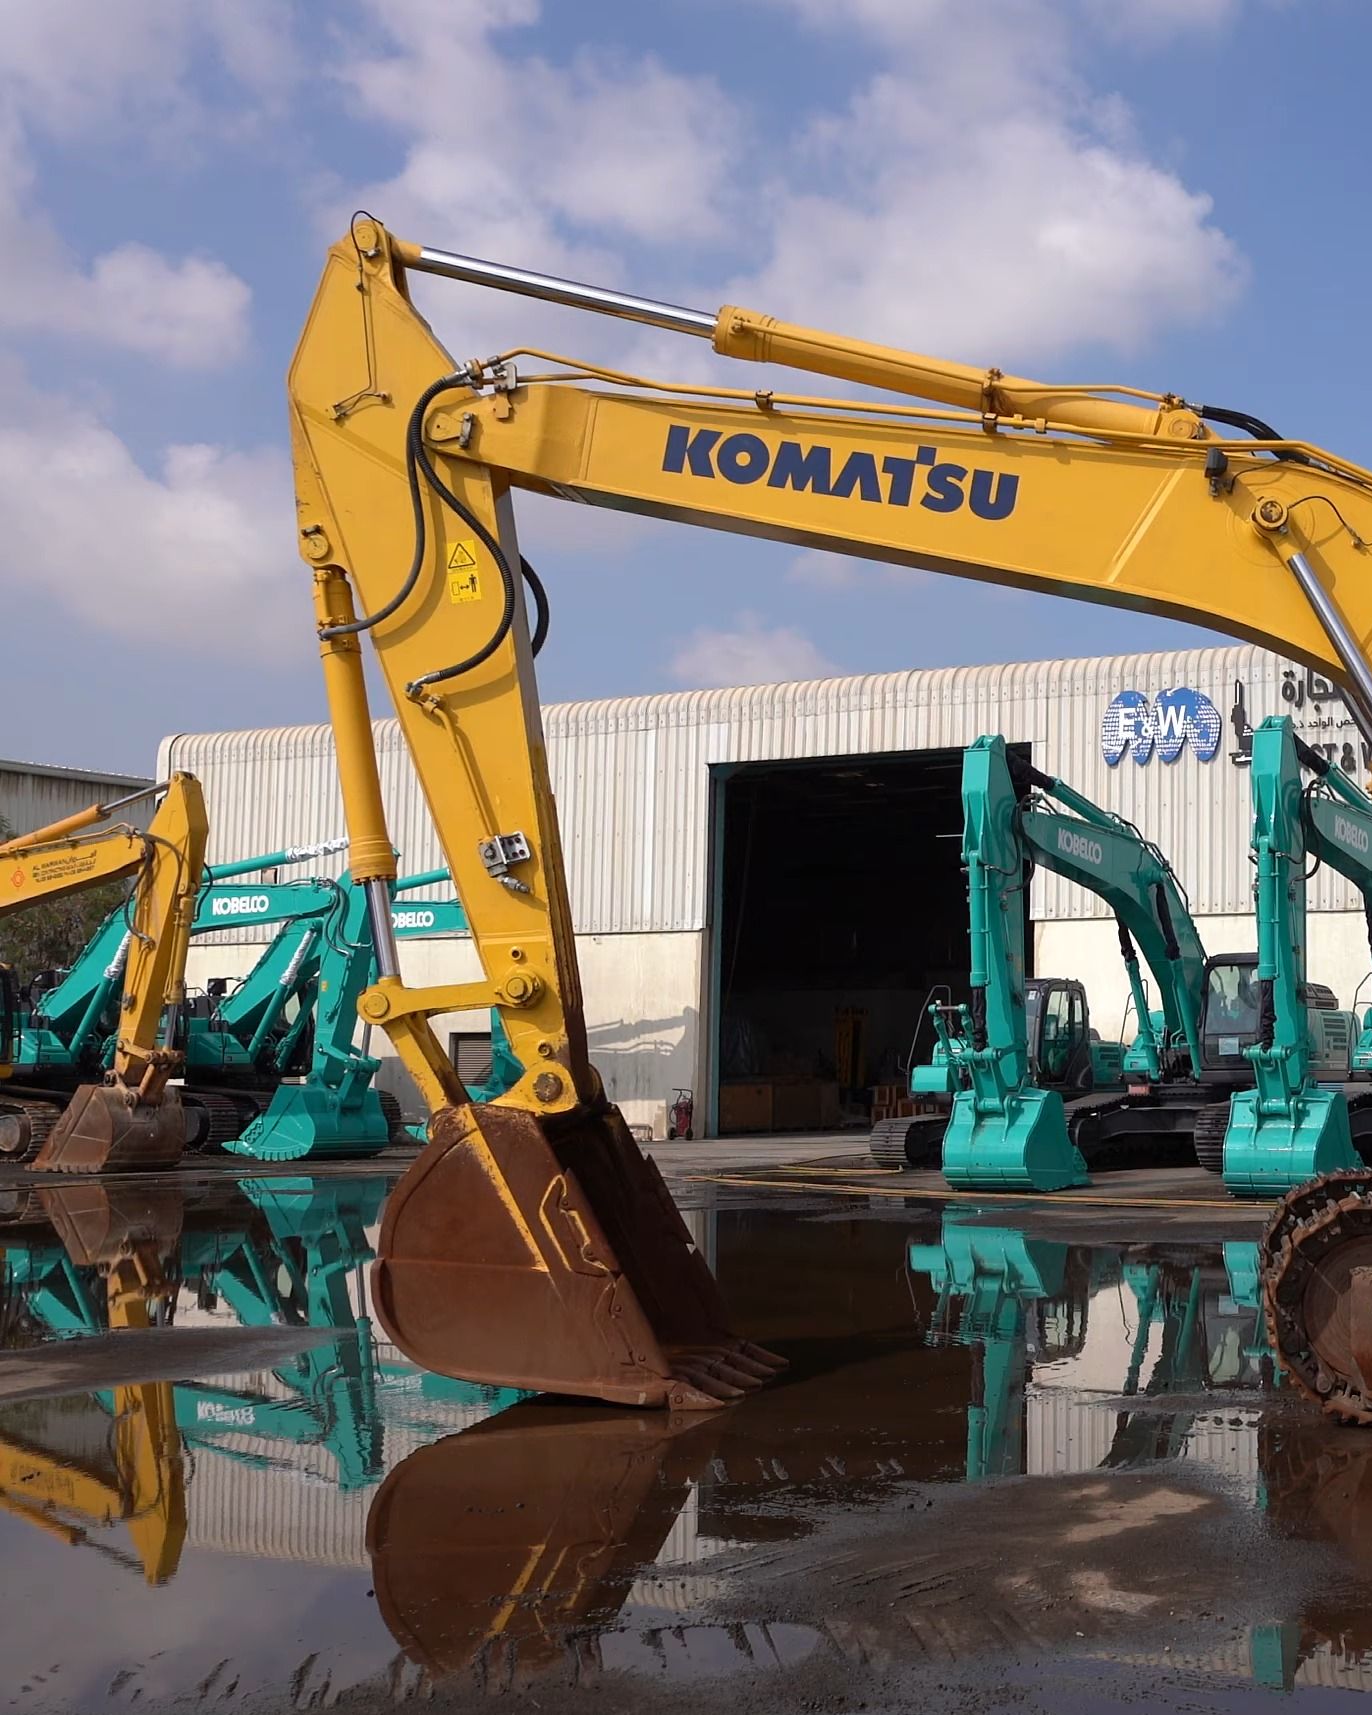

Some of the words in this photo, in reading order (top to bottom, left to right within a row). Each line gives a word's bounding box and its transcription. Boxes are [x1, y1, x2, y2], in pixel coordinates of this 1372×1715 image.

[662, 424, 1020, 520] KOMATSU
[1057, 828, 1102, 865] KOBELCO
[1334, 814, 1369, 852] KOBELCO
[212, 895, 269, 916] KOBELCO
[391, 911, 434, 928] OBELCO
